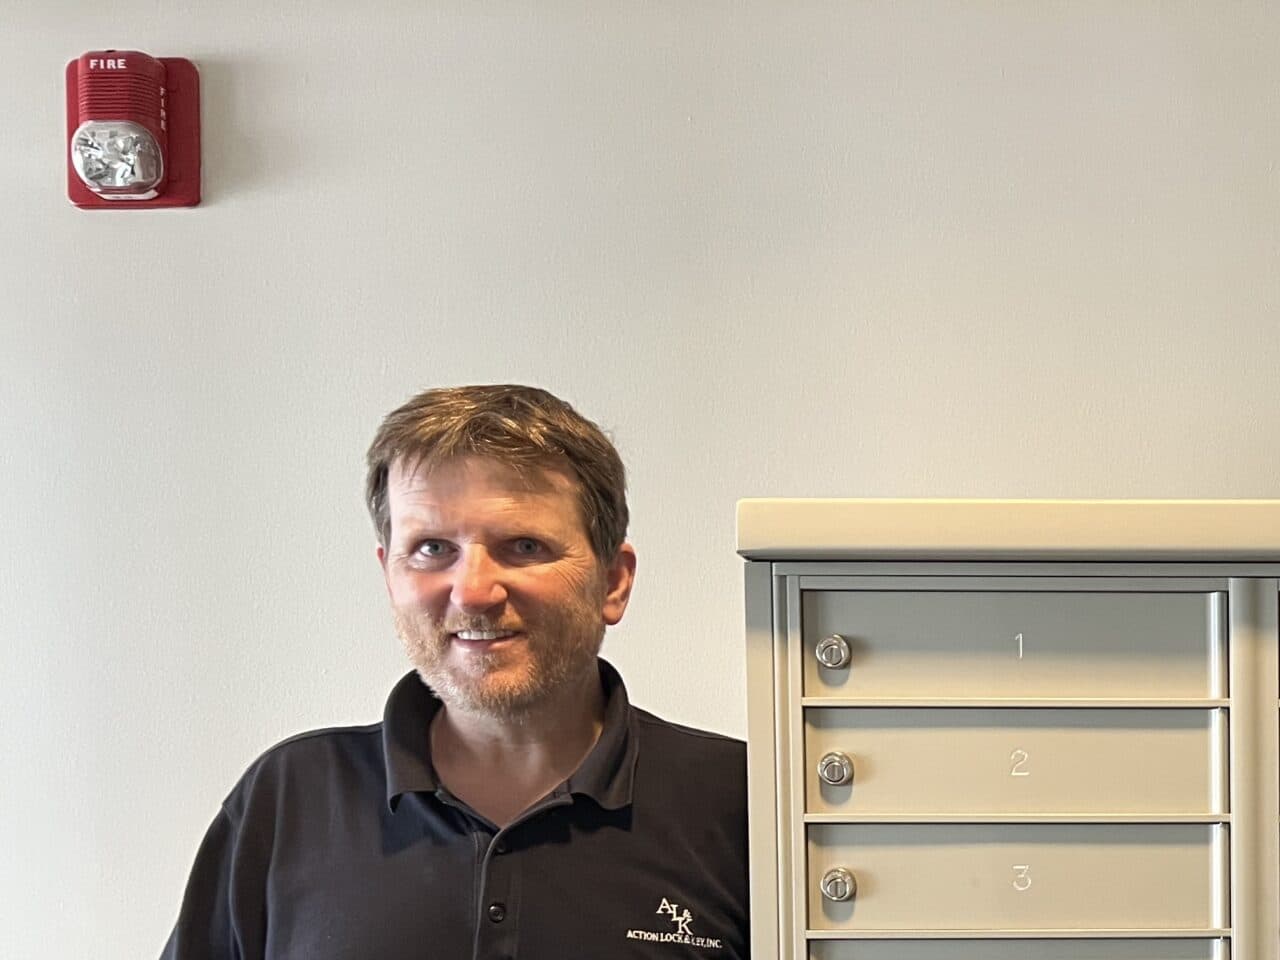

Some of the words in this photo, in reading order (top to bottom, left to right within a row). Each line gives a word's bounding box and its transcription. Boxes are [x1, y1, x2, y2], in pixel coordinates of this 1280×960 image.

[89, 59, 127, 69] FIRE
[1014, 632, 1024, 660] 1
[1009, 750, 1031, 776] 2
[1012, 865, 1032, 891] 3
[626, 929, 658, 942] ACTION
[660, 932, 683, 944] LOCK
